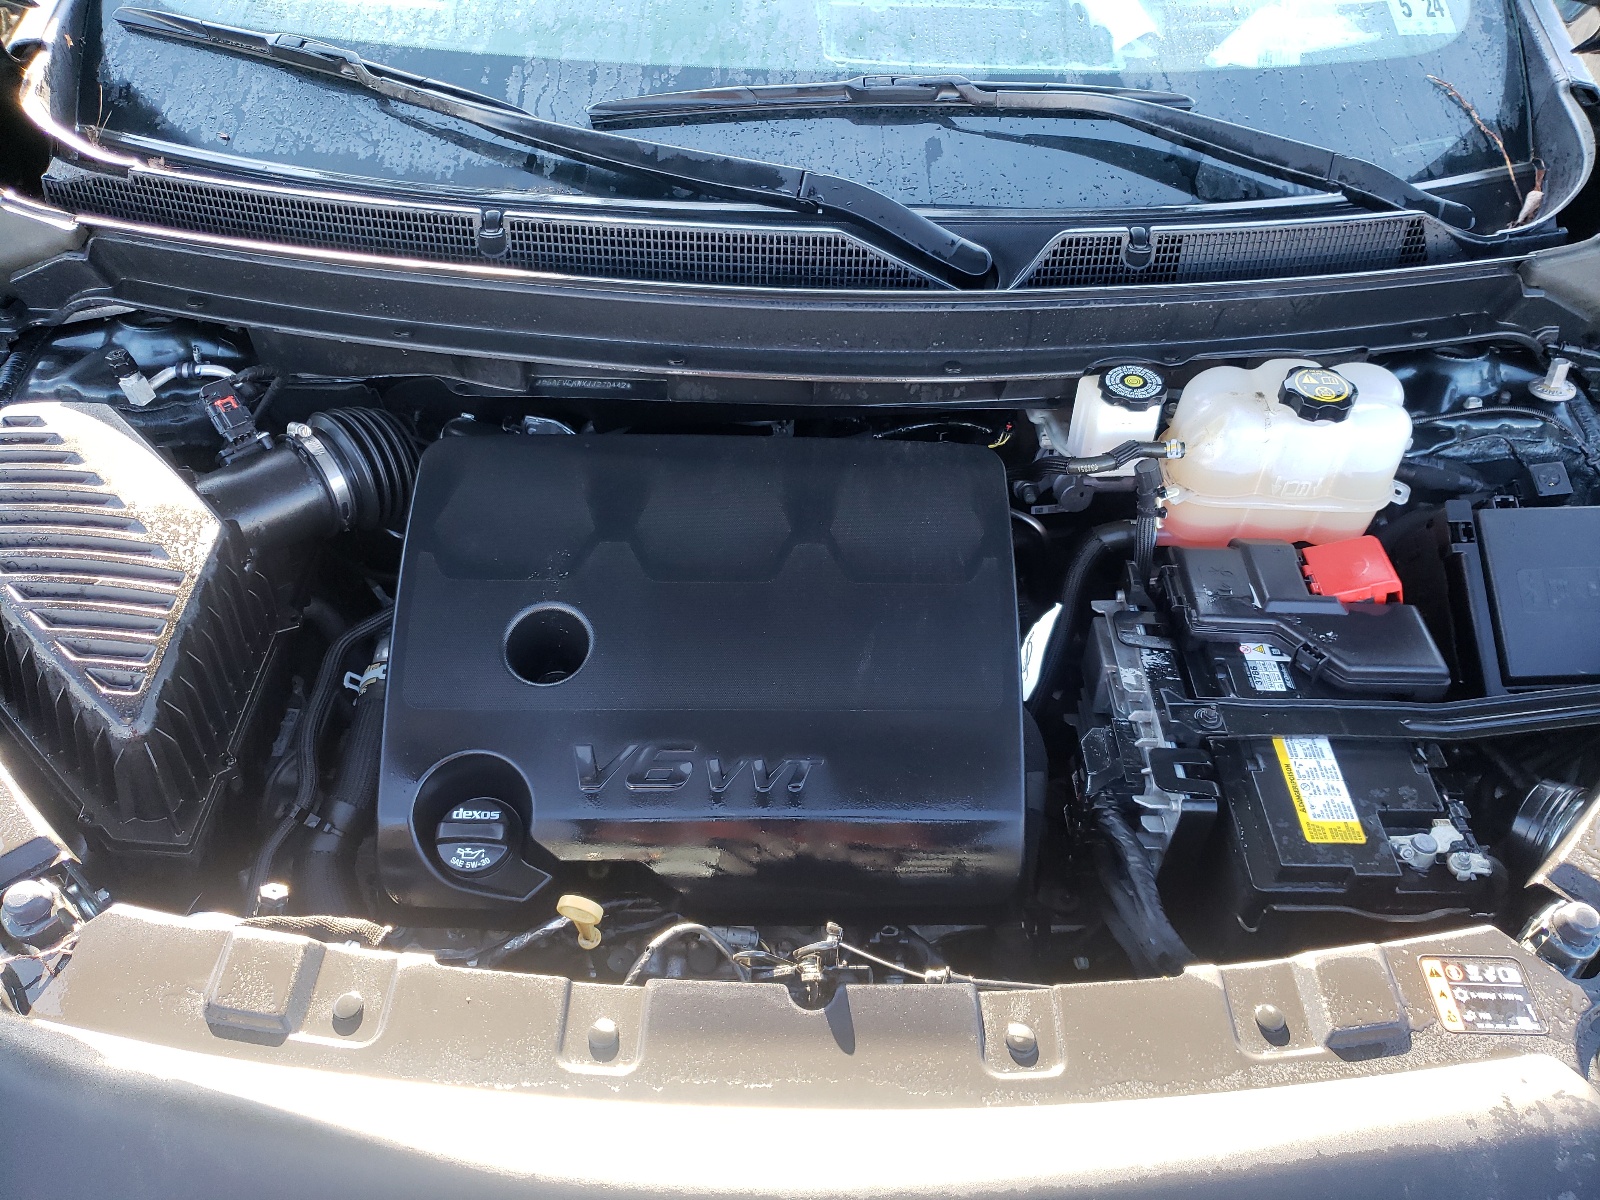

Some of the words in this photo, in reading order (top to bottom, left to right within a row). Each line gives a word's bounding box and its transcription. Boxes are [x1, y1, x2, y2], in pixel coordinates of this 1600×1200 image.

[1426, 0, 1445, 17] 24
[1250, 665, 1262, 686] 3786
[574, 743, 697, 792] V6
[706, 757, 825, 793] VVT
[452, 807, 502, 820] dexos
[450, 856, 464, 867] SAE
[465, 857, 491, 869] 5W-30
